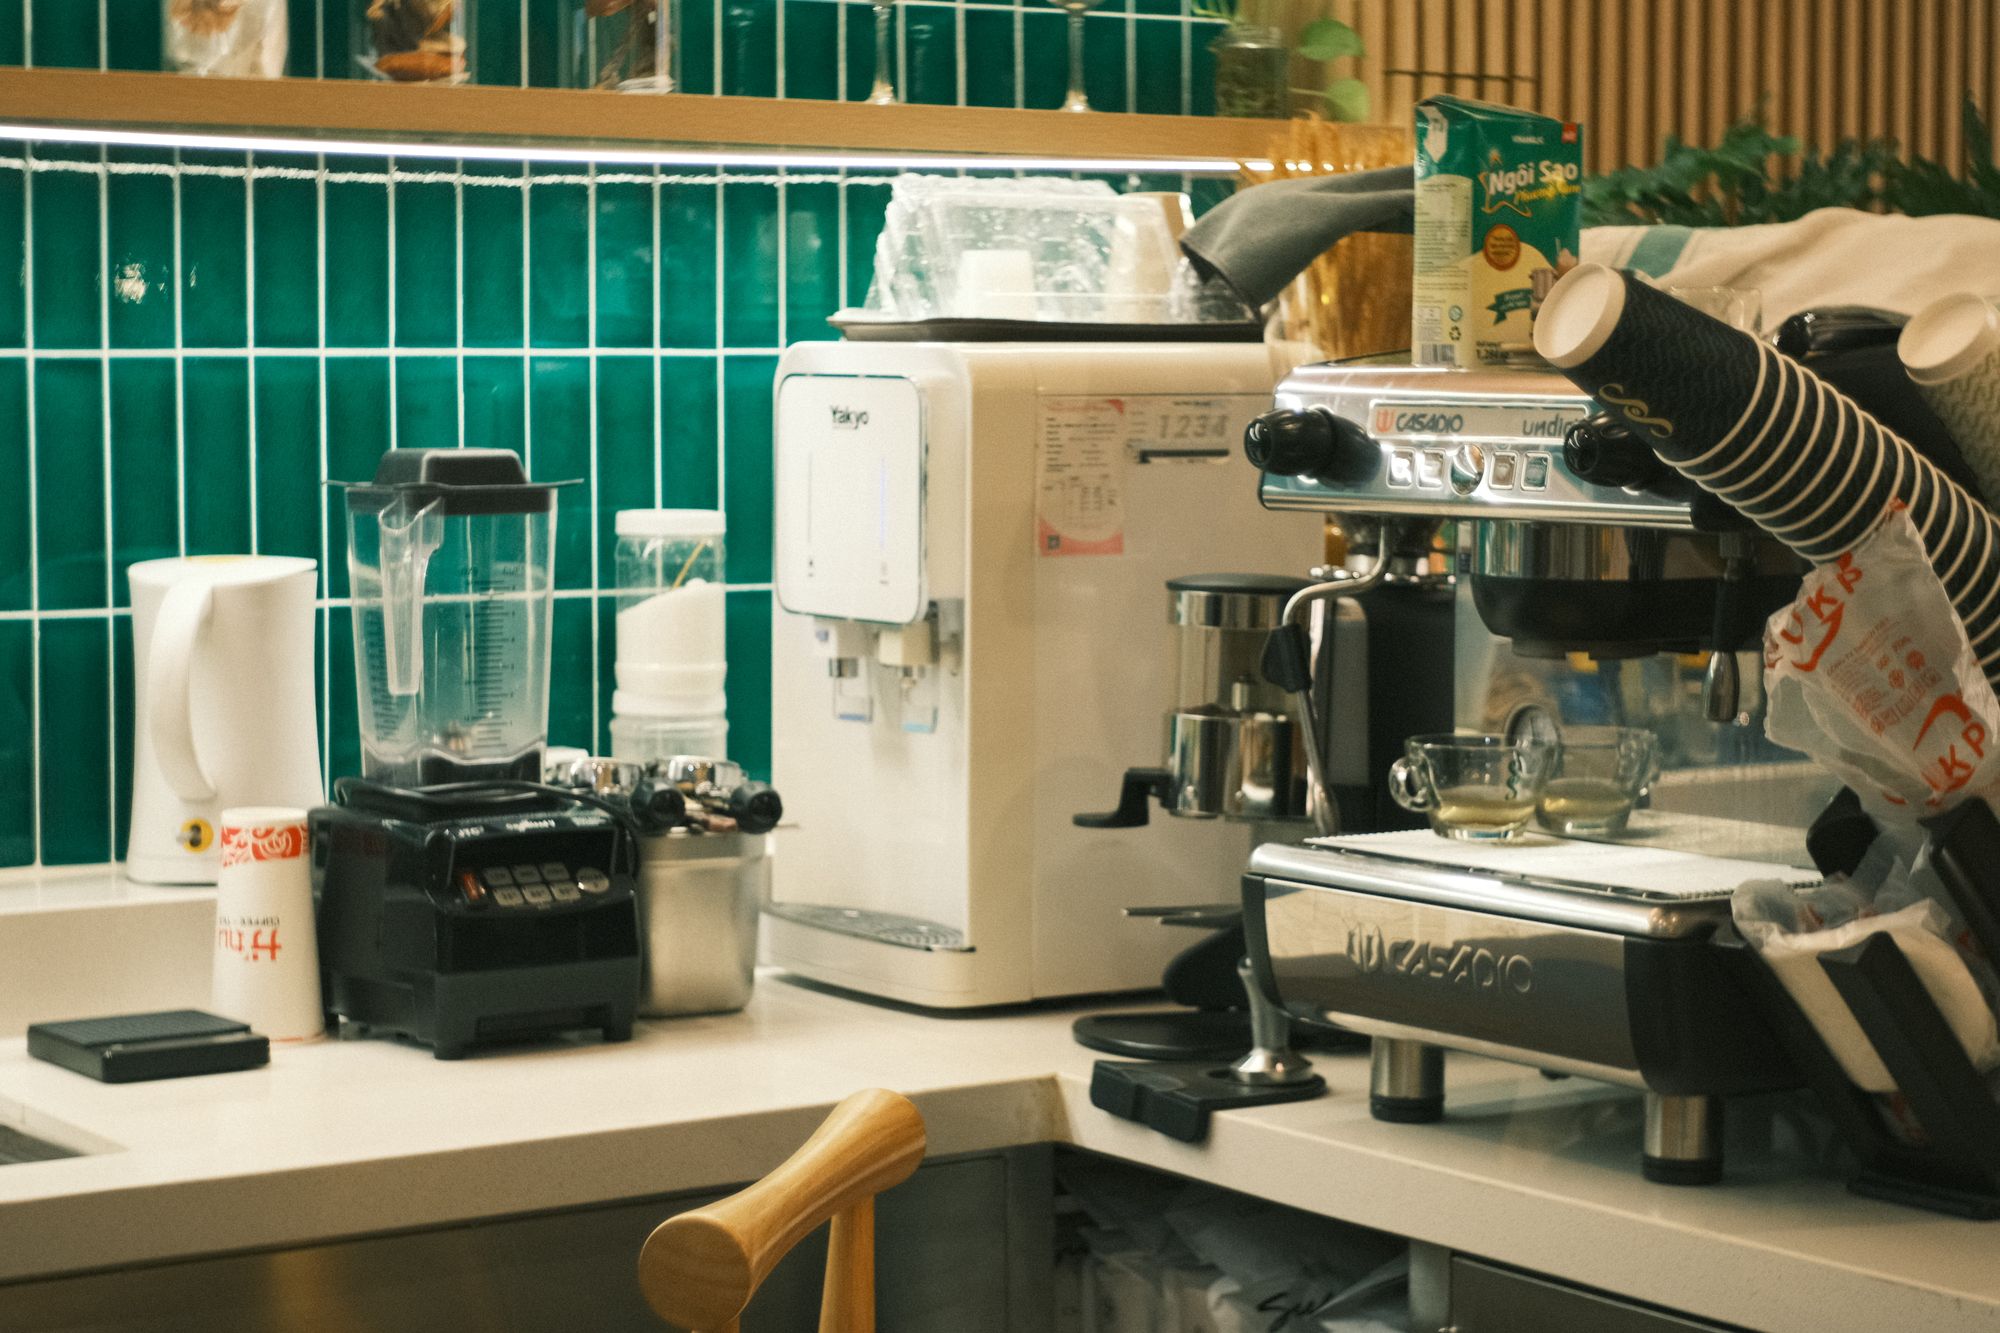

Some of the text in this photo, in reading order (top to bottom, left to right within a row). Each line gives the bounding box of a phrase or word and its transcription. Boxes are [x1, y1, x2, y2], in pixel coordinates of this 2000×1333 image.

[1489, 160, 1579, 196] Ngôi Sao
[830, 405, 869, 430] Yakyo
[1396, 412, 1464, 432] CASADIO
[1386, 937, 1536, 994] CASADIO
